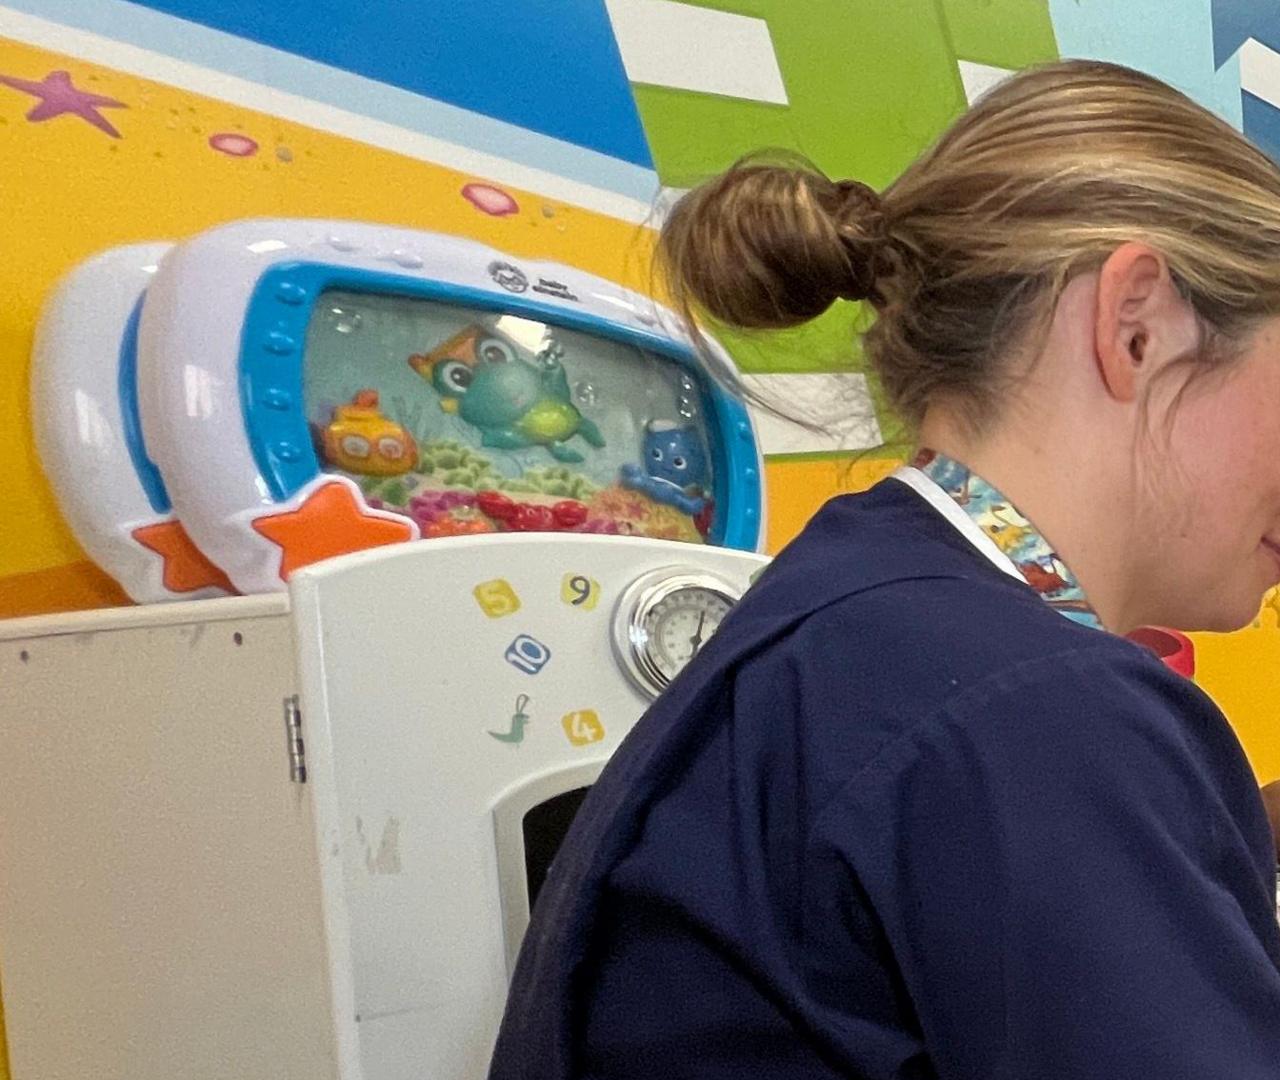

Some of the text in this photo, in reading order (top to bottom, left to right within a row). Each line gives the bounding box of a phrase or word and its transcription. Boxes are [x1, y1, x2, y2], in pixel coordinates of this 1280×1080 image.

[570, 576, 591, 605] 9
[507, 636, 549, 674] 10
[571, 713, 597, 741] 4
